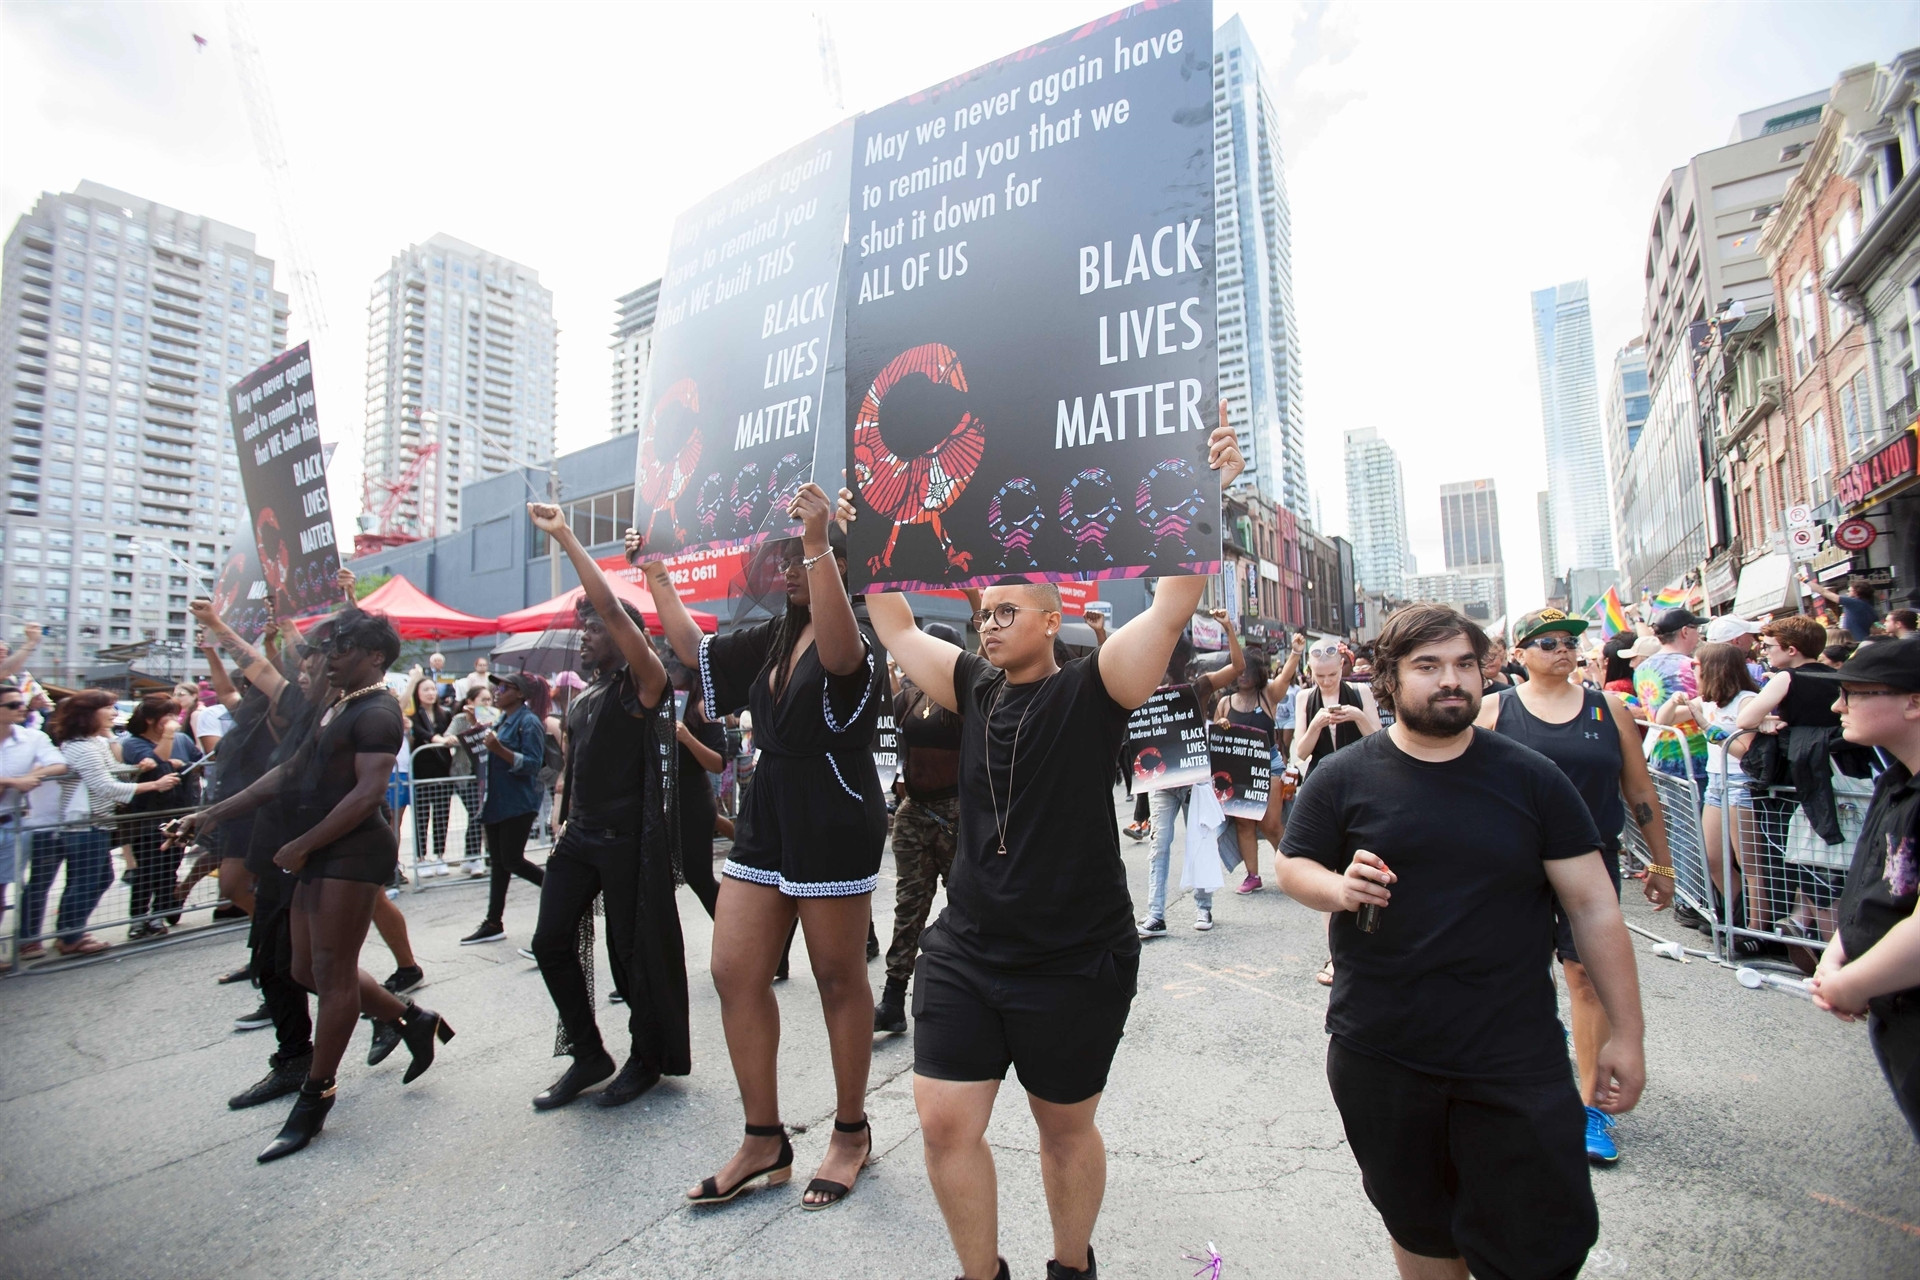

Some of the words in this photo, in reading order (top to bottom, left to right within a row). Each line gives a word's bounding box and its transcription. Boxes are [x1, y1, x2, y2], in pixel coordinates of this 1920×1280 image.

[864, 128, 909, 166] May
[916, 116, 946, 146] we
[954, 86, 1021, 132] never
[1029, 55, 1102, 106] again
[1114, 28, 1184, 73] have
[862, 184, 882, 210] to
[889, 141, 967, 202] remind
[975, 135, 1020, 178] you
[1029, 108, 1082, 152] that
[1091, 99, 1130, 131] we
[707, 206, 726, 231] we
[730, 179, 777, 218] never
[780, 149, 832, 194] again
[860, 220, 904, 258] shut
[911, 210, 926, 240] it
[933, 191, 995, 233] down
[1005, 173, 1042, 210] for
[667, 258, 699, 290] have
[701, 247, 716, 272] to
[720, 204, 781, 263] remind
[782, 198, 818, 239] you
[1080, 218, 1203, 295] BLACK
[659, 297, 687, 332] that
[690, 280, 713, 317] WE
[714, 259, 752, 305] built
[756, 241, 796, 286] THIS
[859, 265, 894, 304] ALL
[902, 252, 931, 290] OF
[938, 241, 969, 280] US
[761, 282, 830, 340] BLACK
[1100, 297, 1203, 366] LIVES
[764, 337, 820, 390] LIVES
[236, 393, 252, 414] May
[251, 386, 263, 404] we
[262, 372, 285, 398] never
[285, 356, 311, 387] again
[243, 412, 260, 442] need
[259, 414, 269, 432] to
[268, 390, 297, 427] remind
[296, 390, 314, 416] you
[734, 395, 812, 451] MATTER
[1055, 378, 1205, 449] MATTER
[254, 443, 271, 466] that
[268, 433, 283, 458] WE
[281, 422, 301, 452] built
[301, 417, 319, 442] this
[293, 452, 323, 486] BLACK
[1839, 462, 1873, 507] CASH
[1872, 455, 1883, 486] 4
[1880, 436, 1910, 482] YOU
[302, 487, 328, 517] LIVES
[300, 521, 335, 555] MATTER
[678, 550, 705, 564] SPACE
[692, 564, 717, 582] 0611
[1141, 708, 1148, 716] to
[1149, 705, 1168, 714] mourn
[1148, 695, 1164, 703] never
[1164, 690, 1181, 701] again
[1128, 718, 1151, 729] another
[1151, 715, 1162, 725] life
[1162, 713, 1174, 724] like
[1175, 711, 1187, 721] that
[1187, 708, 1194, 719] of
[1129, 729, 1151, 740] Andrew
[1152, 726, 1167, 736] Loku
[1180, 727, 1205, 741] BLACK
[880, 734, 897, 748] LIVES
[1186, 741, 1207, 754] LIVES
[1210, 732, 1223, 743] May
[1233, 737, 1249, 746] never
[1249, 739, 1265, 749] again
[1210, 743, 1224, 753] have
[1225, 746, 1231, 754] to
[1232, 746, 1247, 756] SHUT
[1247, 748, 1254, 757] IT
[1253, 749, 1270, 760] DOWN
[1180, 755, 1209, 769] MATTER
[1250, 766, 1270, 778] BLACK
[1244, 789, 1268, 802] MATTER
[1253, 779, 1270, 790] LIVES
